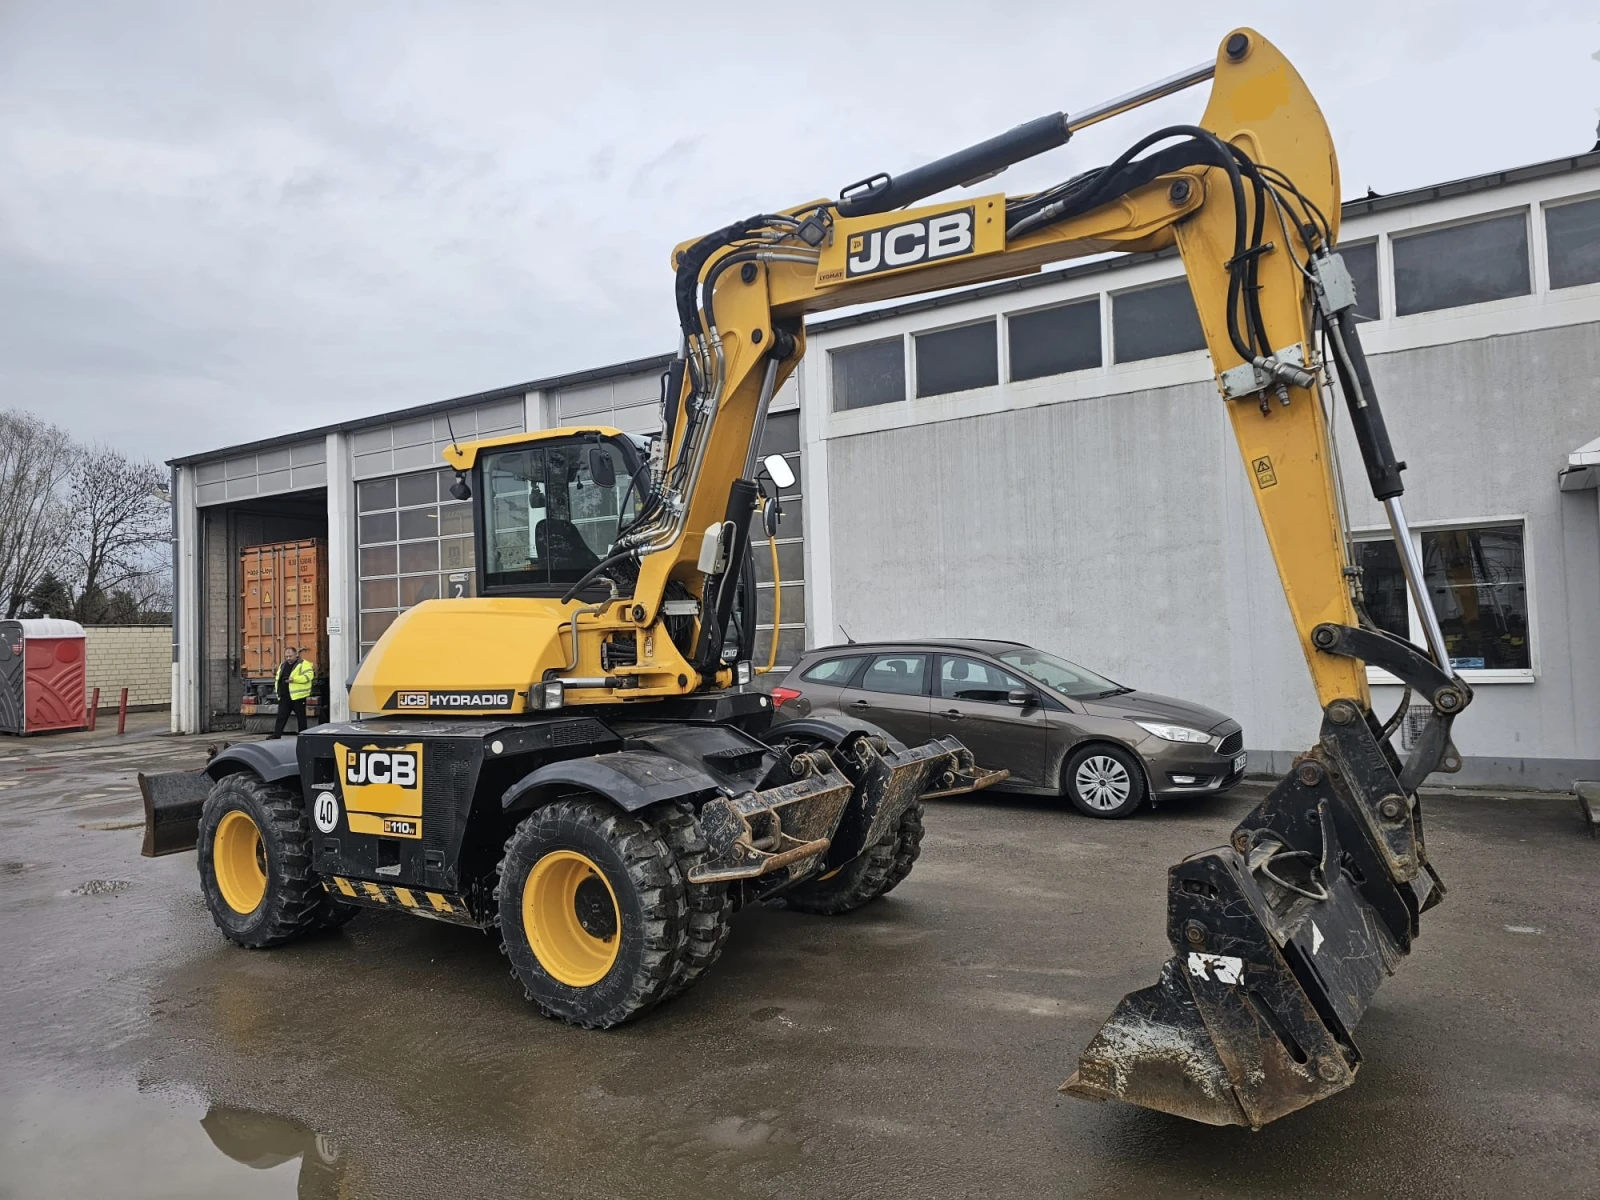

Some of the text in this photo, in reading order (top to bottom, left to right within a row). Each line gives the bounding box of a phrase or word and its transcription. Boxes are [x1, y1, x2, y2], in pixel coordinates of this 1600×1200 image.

[849, 212, 972, 273] JCB
[455, 584, 464, 599] 2
[400, 694, 509, 706] JCB HYDRADIG
[347, 752, 416, 786] JCB
[319, 800, 333, 825] 40
